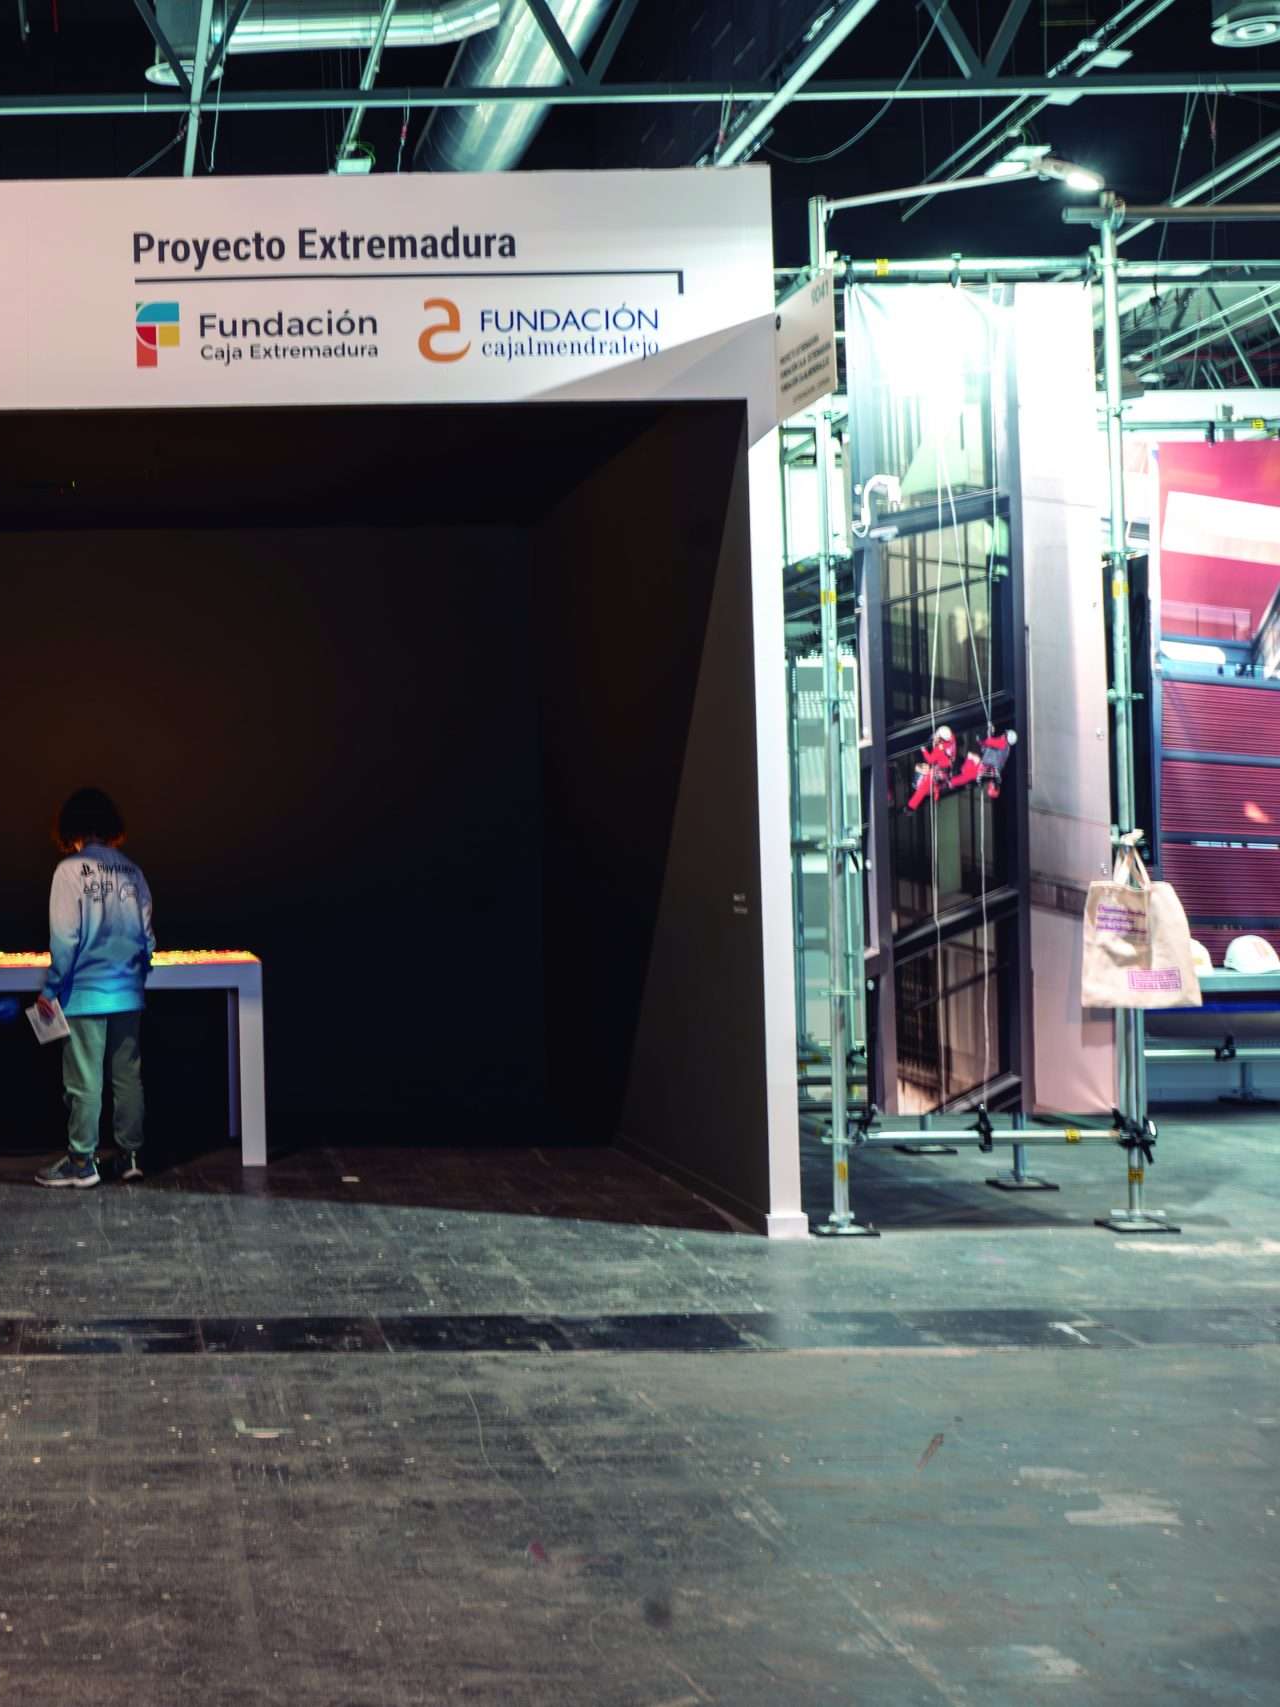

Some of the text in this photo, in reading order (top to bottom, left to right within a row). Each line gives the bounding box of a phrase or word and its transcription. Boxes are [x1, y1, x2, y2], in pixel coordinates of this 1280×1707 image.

[133, 226, 517, 271] Proyecto Extremadura
[199, 310, 378, 338] Fundación
[480, 302, 659, 333] FUNDACIÓN
[200, 343, 379, 366] Caja Extremadura
[481, 336, 660, 361] cajalmendralejo
